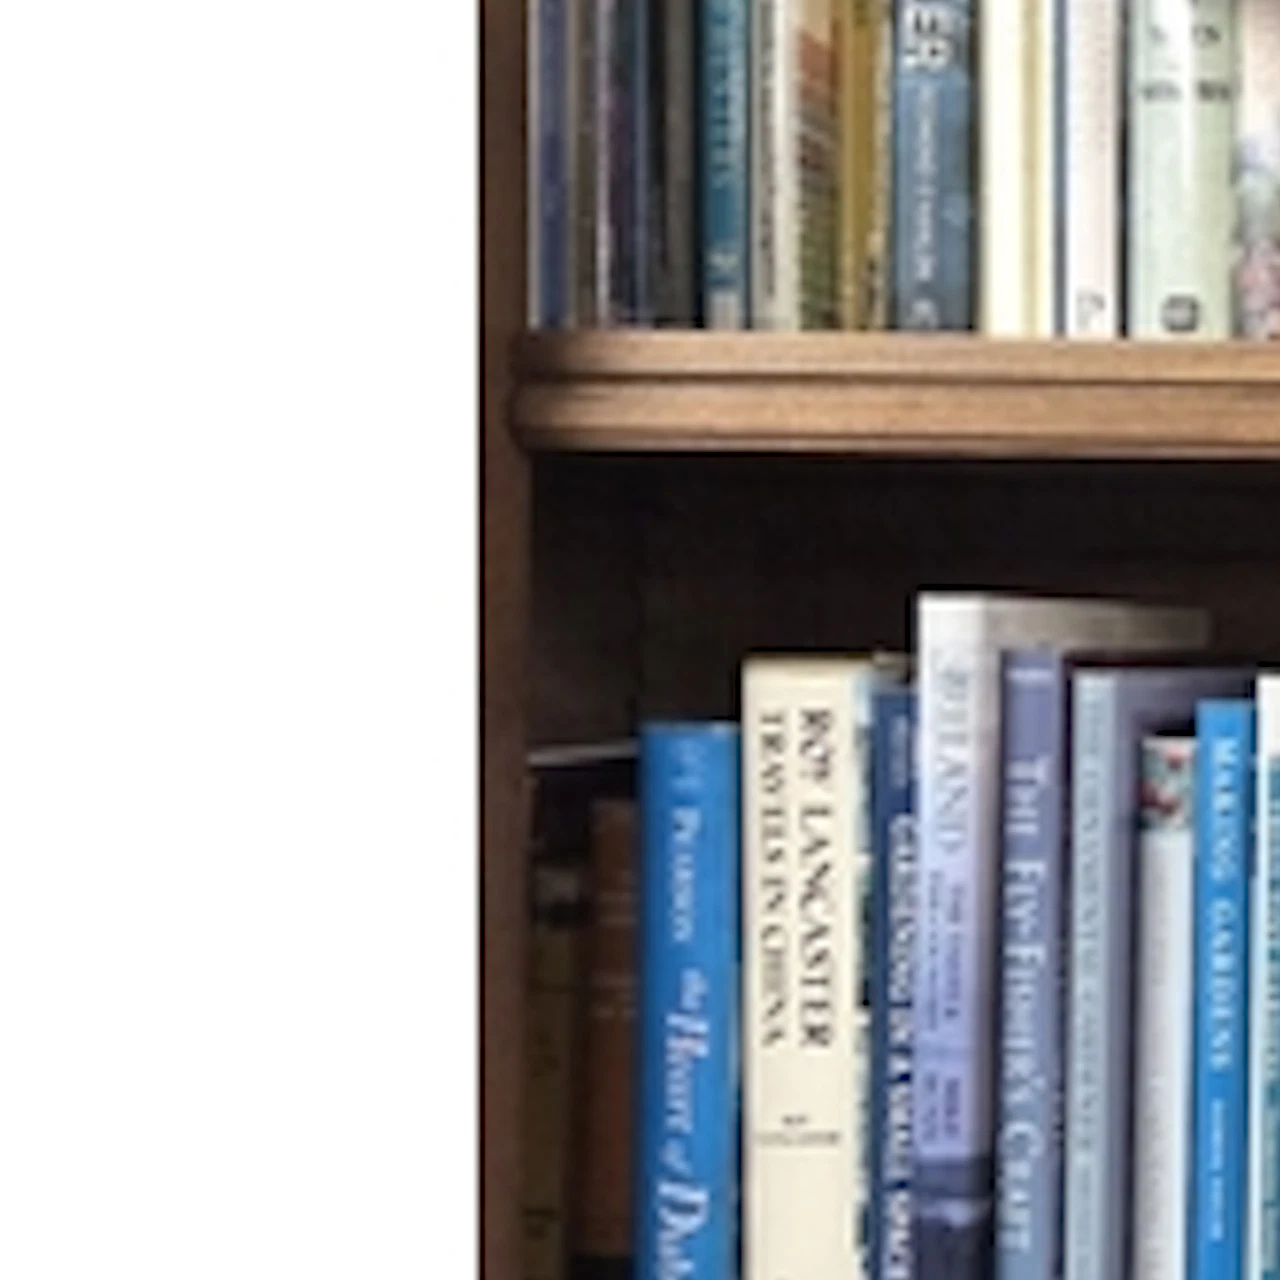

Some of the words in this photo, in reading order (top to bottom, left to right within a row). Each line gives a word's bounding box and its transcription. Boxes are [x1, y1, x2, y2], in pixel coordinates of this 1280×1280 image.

[760, 712, 790, 866] TRAVELS
[799, 707, 836, 783] ROY
[1006, 754, 1050, 837] THE
[1209, 736, 1238, 881] MAKING
[760, 876, 790, 916] IN
[797, 805, 838, 1050] LANCASTER
[760, 923, 790, 1049] CHINA
[1002, 858, 1052, 1105] FLY-FISHER'S
[1207, 899, 1237, 1073] GARDENS
[664, 1013, 711, 1134] Heart
[1002, 1122, 1046, 1254] CRAFT
